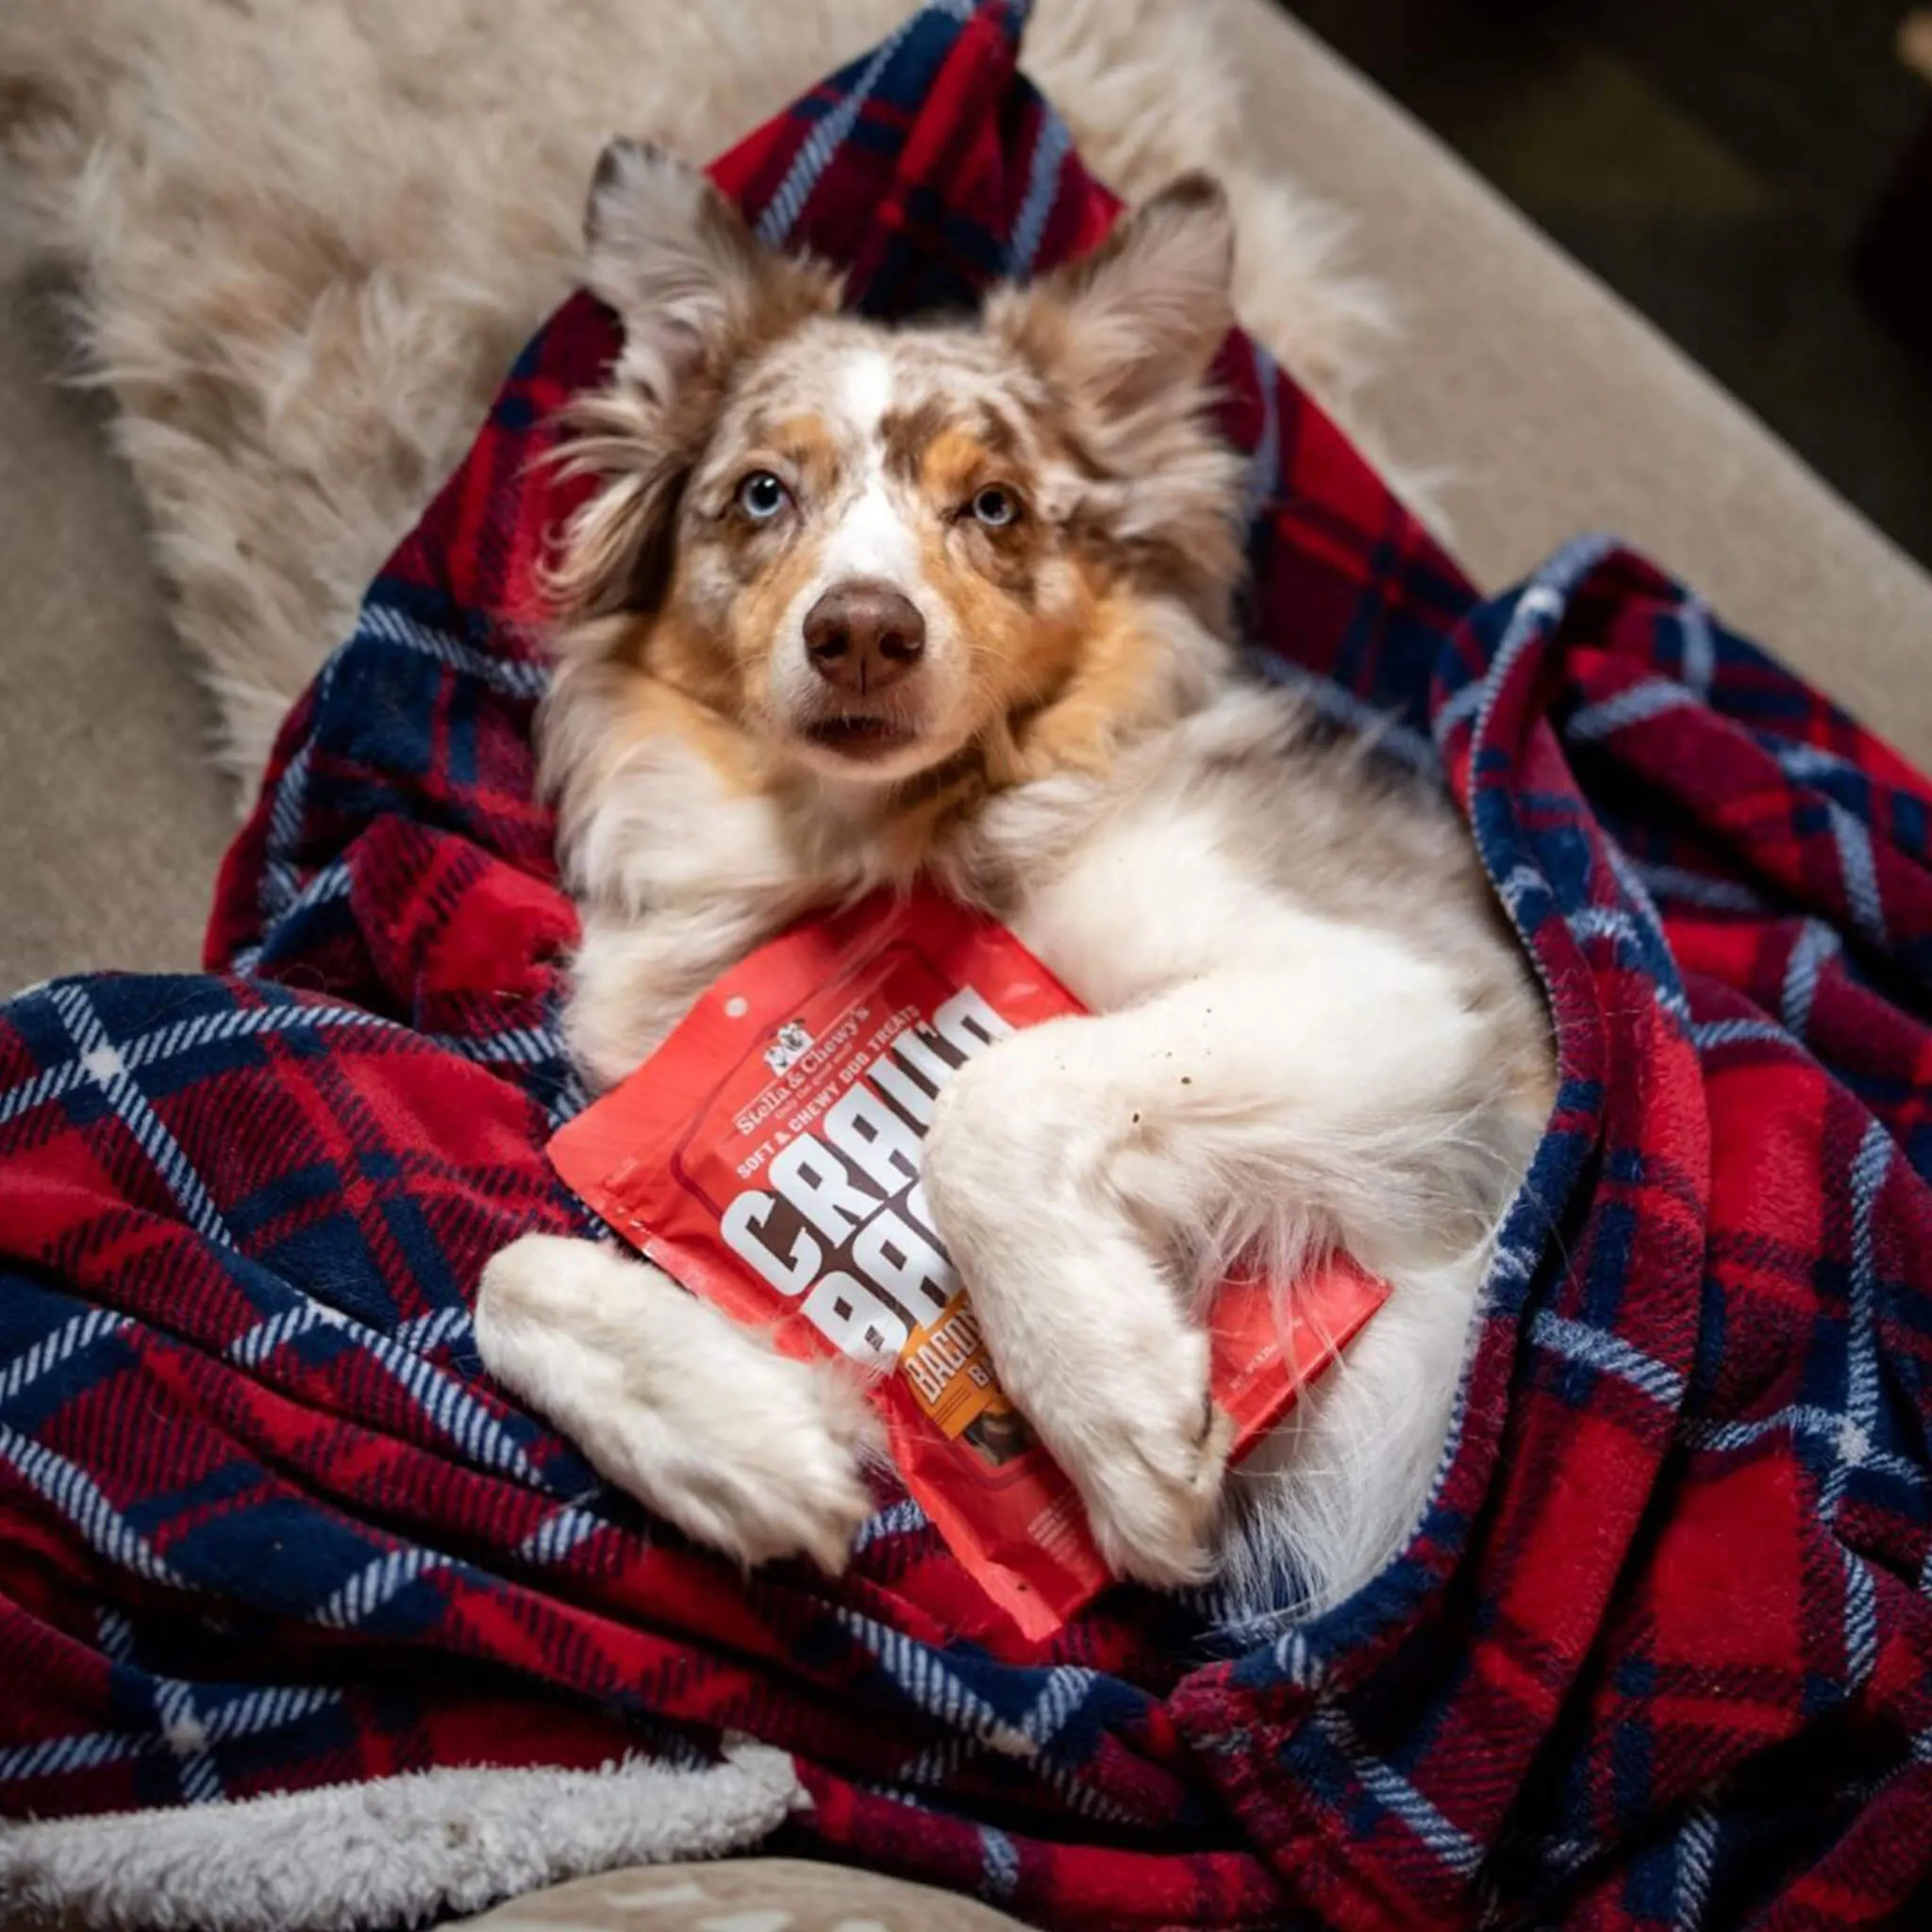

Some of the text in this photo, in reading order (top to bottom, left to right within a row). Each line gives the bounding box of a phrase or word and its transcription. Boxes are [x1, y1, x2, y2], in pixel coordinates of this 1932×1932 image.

[736, 1007, 870, 1136] Stella & Chewy's
[736, 1005, 921, 1179] SOFT & CHEWY DOG TREATS
